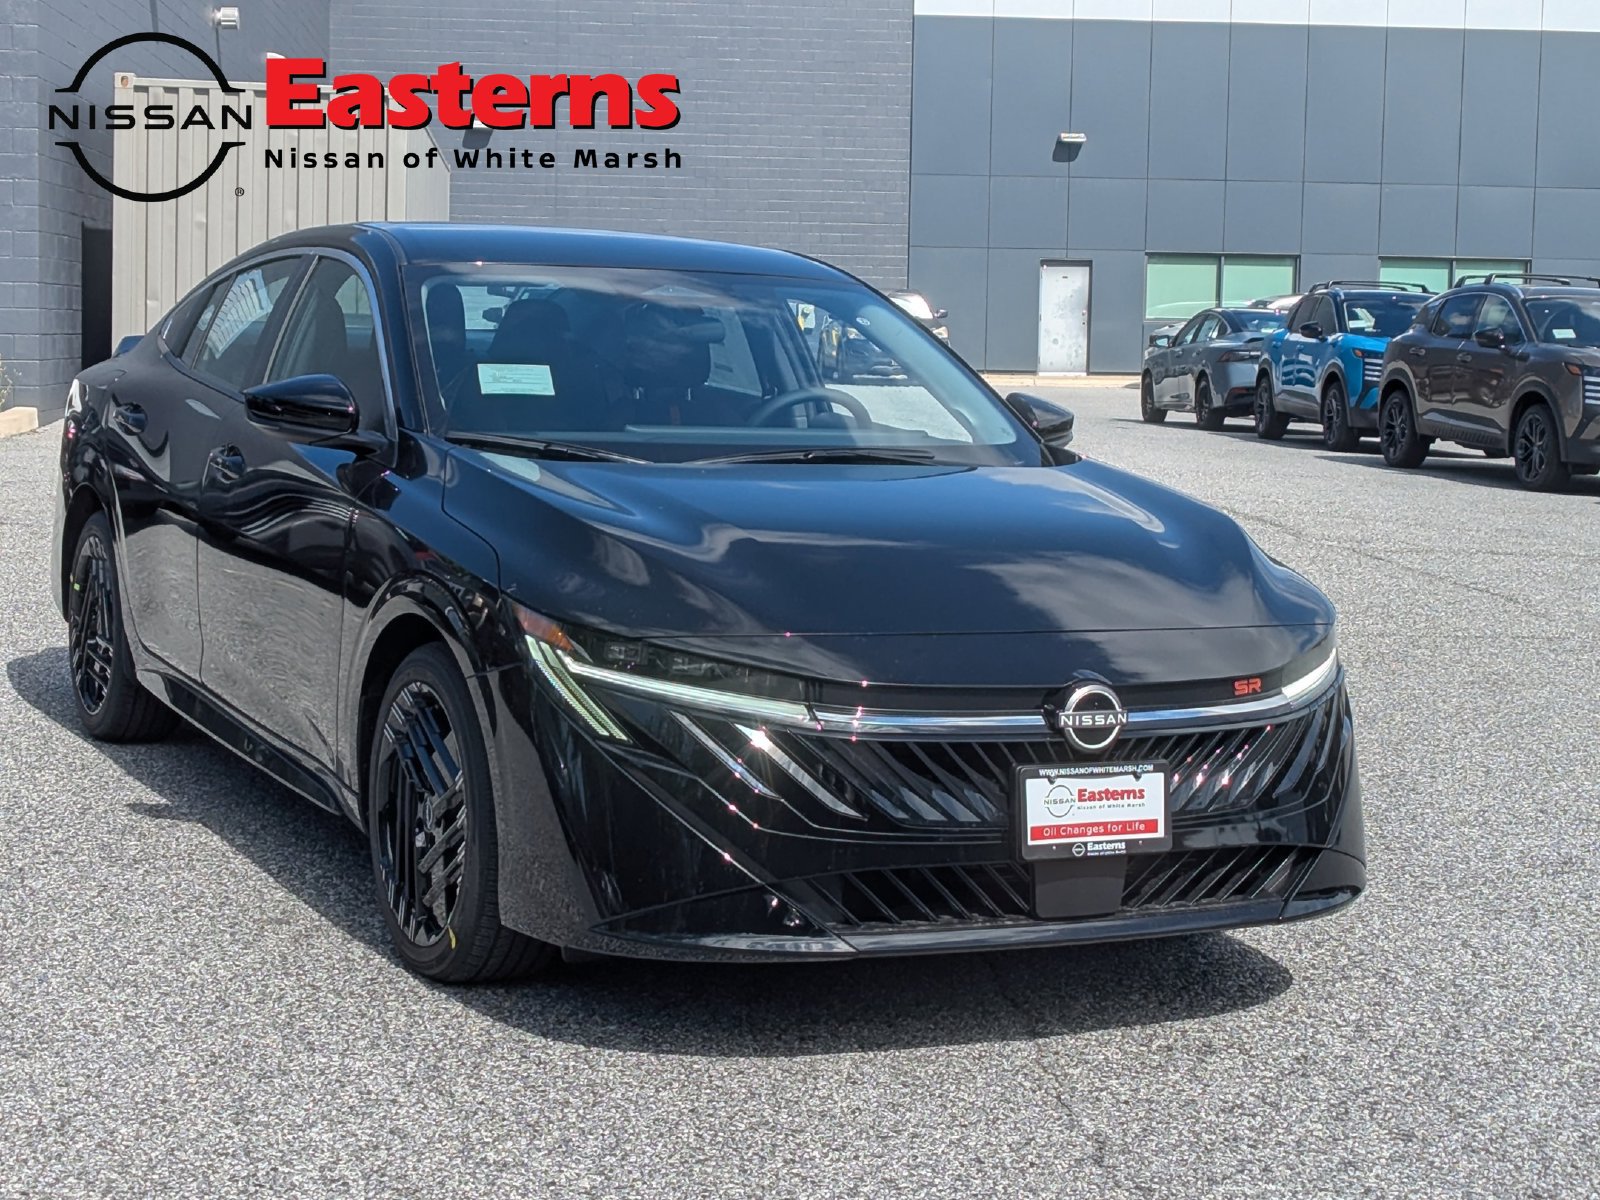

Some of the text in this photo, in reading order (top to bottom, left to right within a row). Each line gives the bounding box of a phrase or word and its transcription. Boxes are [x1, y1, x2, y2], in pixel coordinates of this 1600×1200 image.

[1234, 678, 1262, 696] SR
[1060, 712, 1128, 727] NISSAN
[1043, 797, 1076, 806] NISSAN
[1077, 787, 1146, 803] Easterns
[1043, 821, 1146, 836] Oil Changes for Life
[1086, 842, 1126, 851] Easterns
